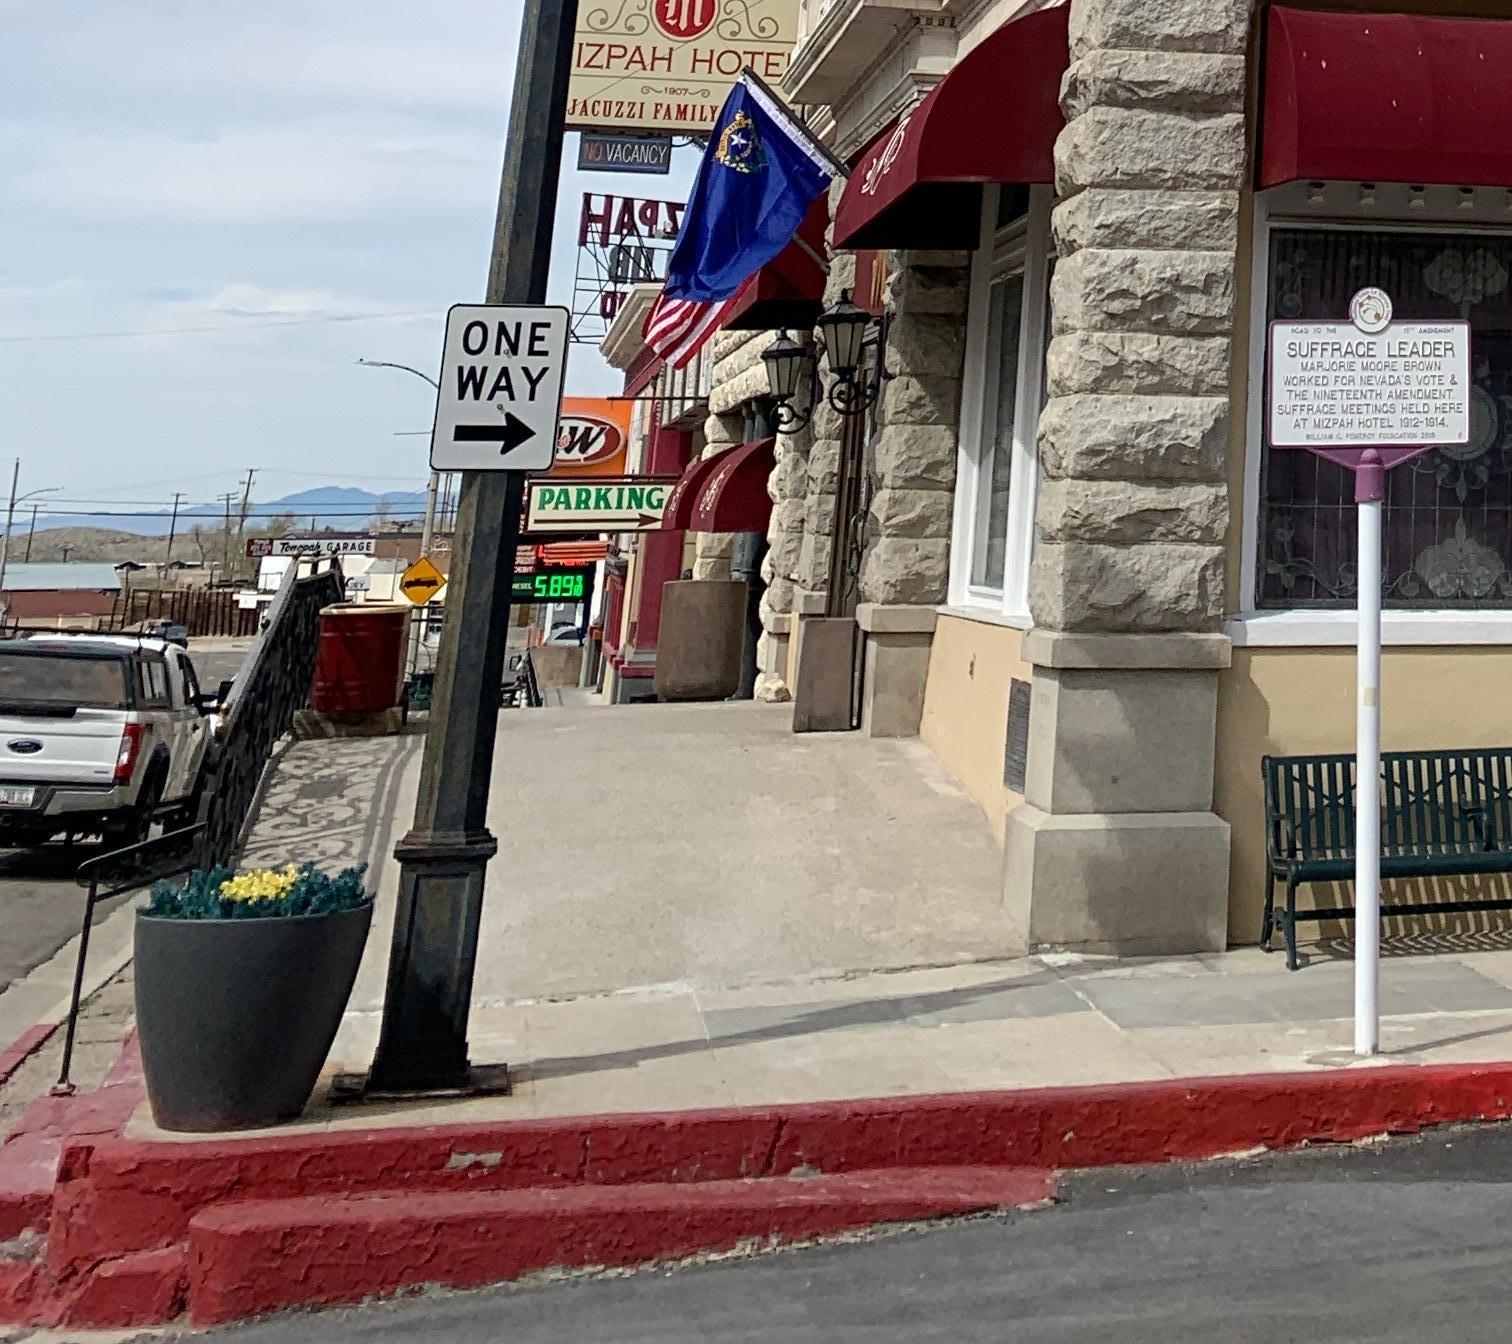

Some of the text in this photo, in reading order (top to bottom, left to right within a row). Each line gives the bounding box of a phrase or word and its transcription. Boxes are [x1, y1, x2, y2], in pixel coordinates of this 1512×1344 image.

[576, 43, 673, 72] IZPAH
[664, 87, 689, 96] 1907
[567, 99, 719, 122] JACUZZI FAMILY
[583, 142, 668, 164] NO VACANCY
[462, 320, 552, 356] ONE
[1287, 341, 1455, 358] SUFFRAGE LEADER
[1301, 361, 1441, 372] MARJORIE MOORE BROWN
[457, 365, 550, 401] WAY
[1283, 373, 1458, 386] WORKED FOR NEVADA'S VOTE &
[1286, 389, 1308, 401] THE
[1313, 389, 1382, 400] NINETEENTH
[1277, 403, 1463, 415] SUFFRAGE MEETINGS HELD HERE
[1293, 418, 1308, 429] AT
[1313, 418, 1353, 429] MIZPAH
[1358, 417, 1394, 428] HOTEL
[556, 425, 608, 455] &W
[537, 487, 665, 511] PARKING
[326, 541, 372, 552] GARAGE
